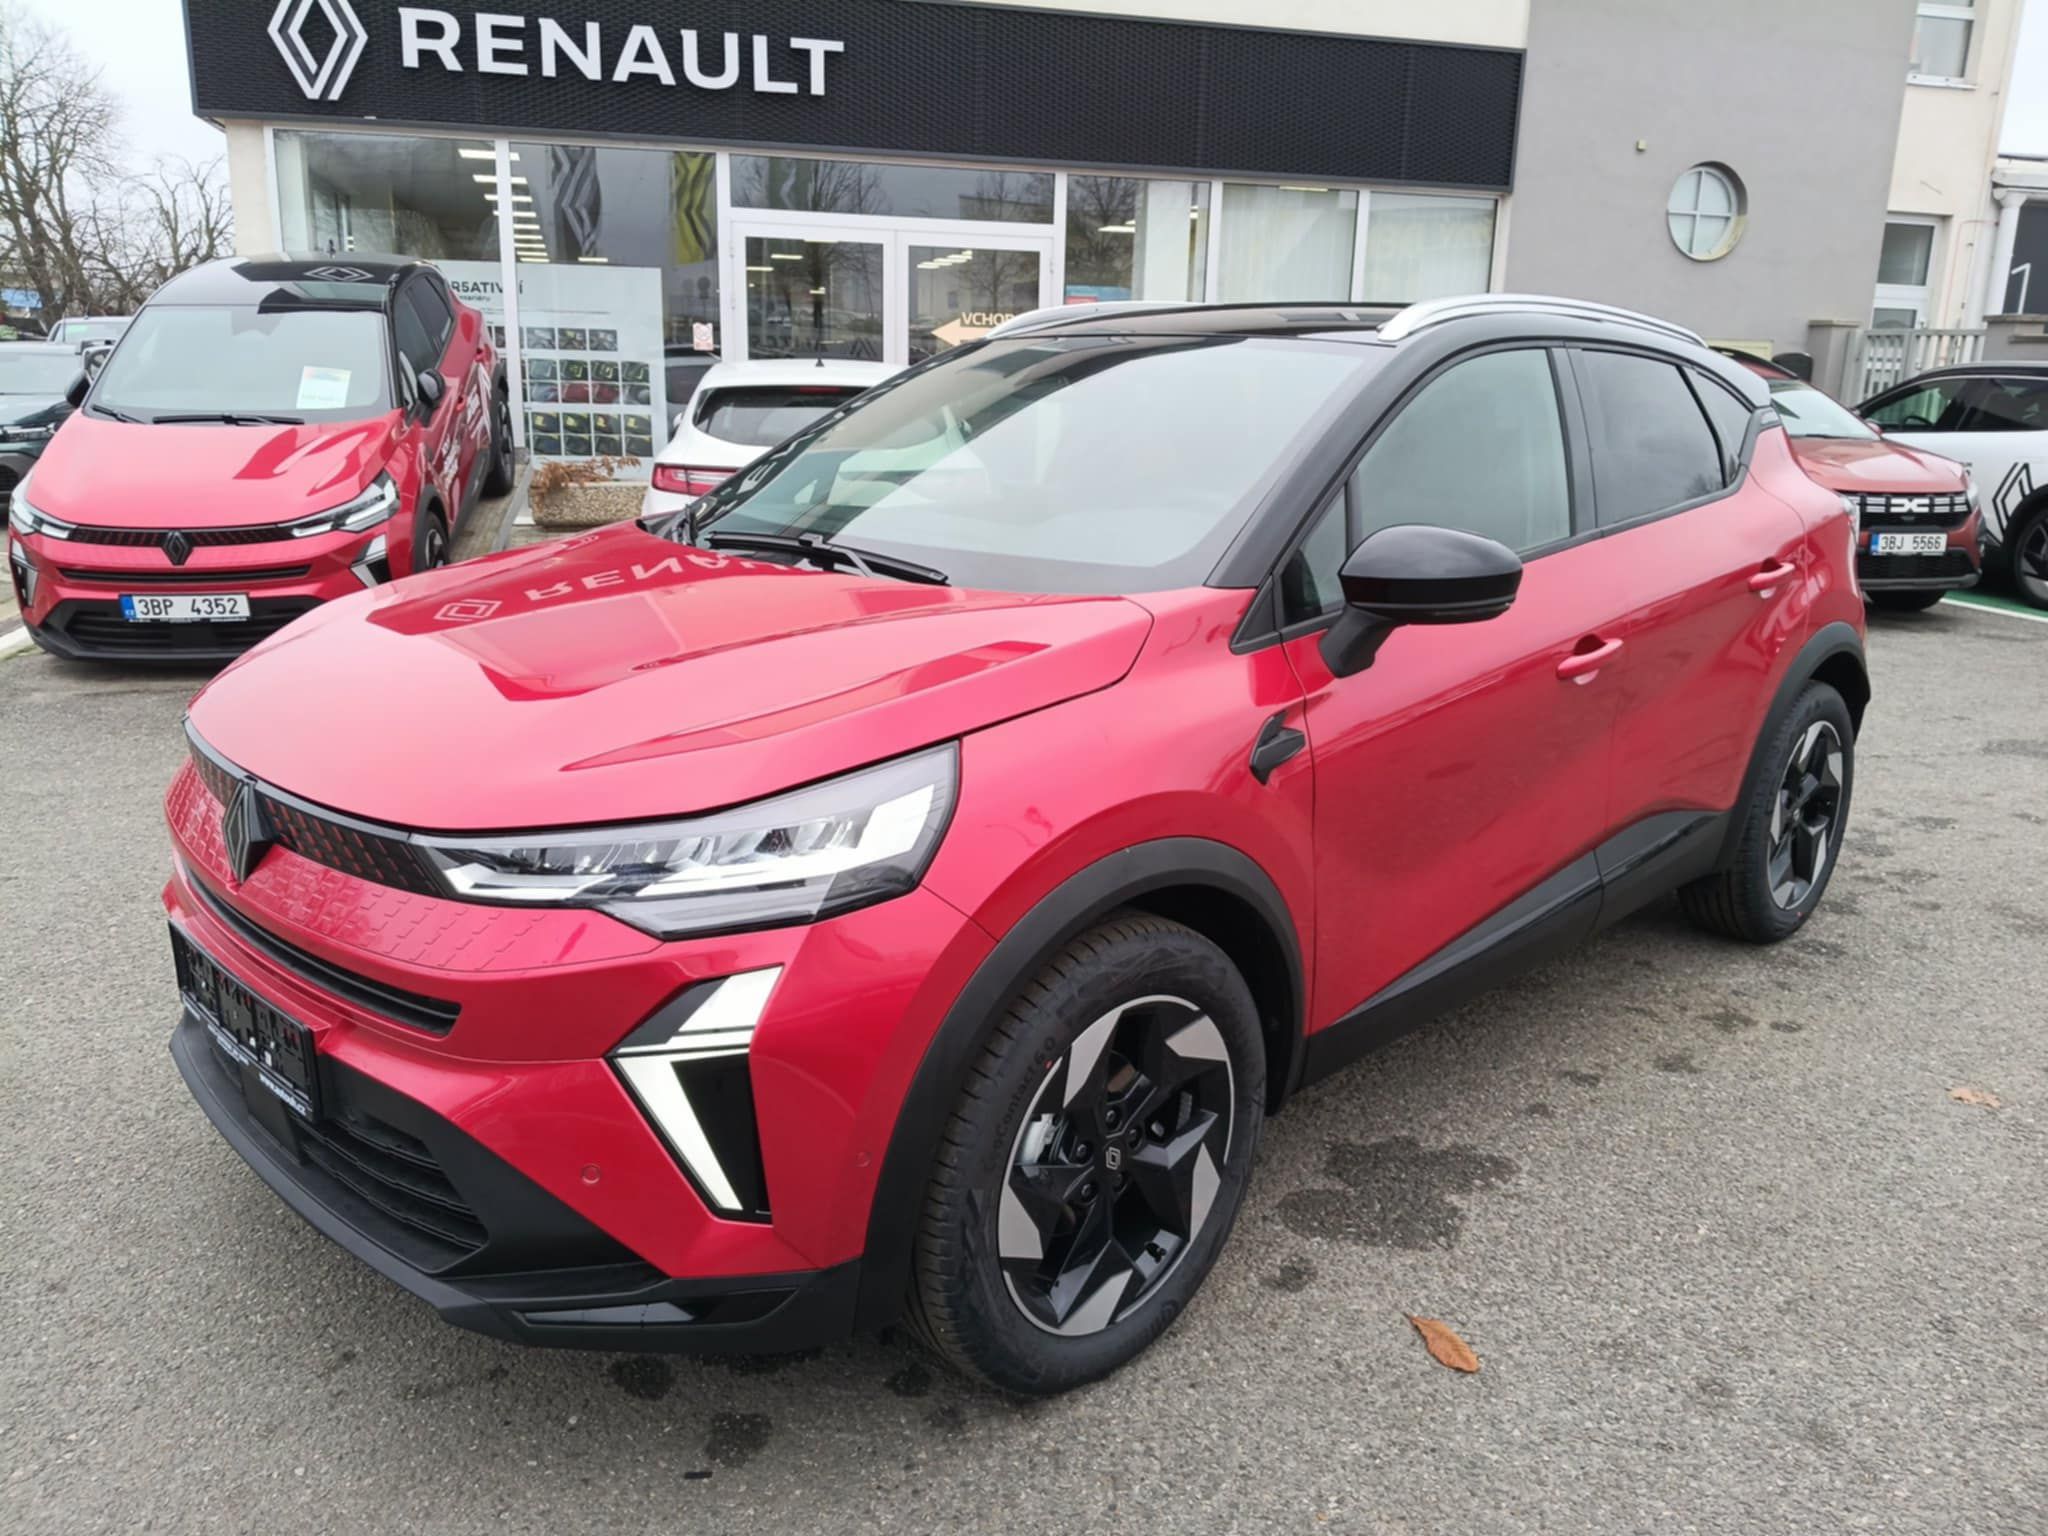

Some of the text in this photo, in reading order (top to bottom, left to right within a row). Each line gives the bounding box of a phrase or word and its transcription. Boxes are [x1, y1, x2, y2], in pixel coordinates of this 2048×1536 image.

[398, 6, 845, 97] RENAULT
[1881, 535, 1942, 550] 3BJ 5566
[138, 598, 174, 616] 3BP
[190, 598, 240, 616] 4352
